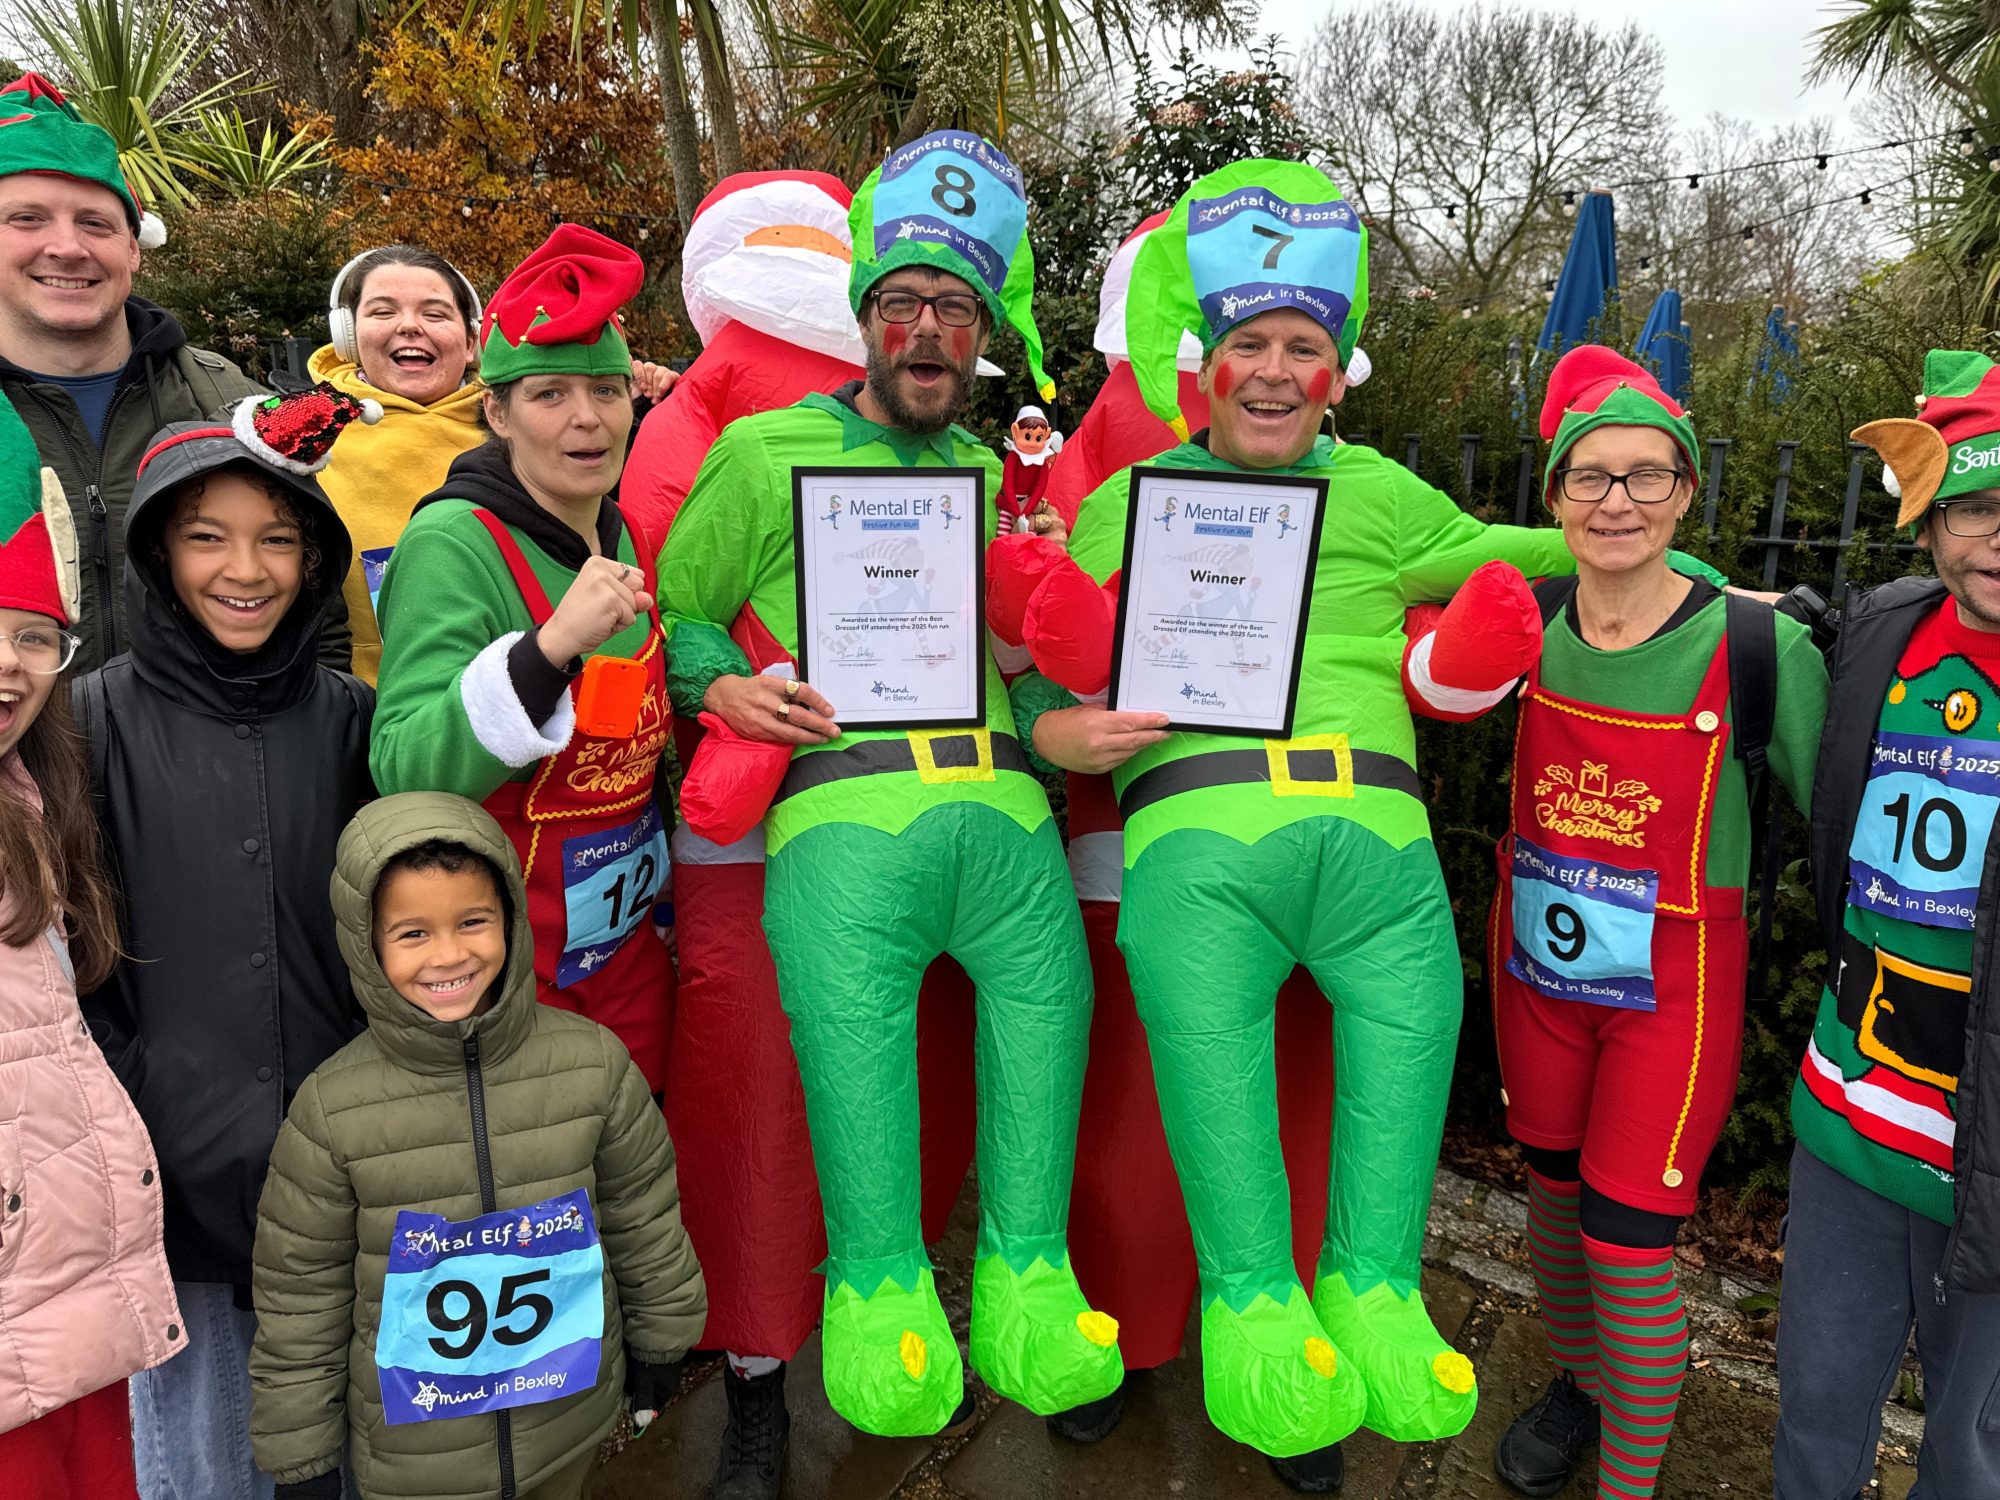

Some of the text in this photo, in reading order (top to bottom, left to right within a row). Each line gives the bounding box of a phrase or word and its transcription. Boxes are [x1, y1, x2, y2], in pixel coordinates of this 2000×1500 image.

[896, 137, 1013, 178] Mental Elf 2025
[931, 164, 977, 218] 8
[1207, 196, 1338, 222] Mental Elf 2025
[913, 223, 992, 275] mind in Bexley
[1252, 224, 1294, 269] 7
[1236, 289, 1275, 310] mind
[1296, 290, 1331, 318] Bexley
[850, 498, 933, 517] Mental Elf
[1184, 503, 1271, 524] Mental Elf
[863, 520, 918, 529] Festive Fun Run
[1196, 525, 1222, 534] Festive
[1223, 527, 1236, 535] Fun
[864, 566, 919, 578] Winner
[1190, 569, 1246, 586] Winner
[893, 695, 918, 703] Bexley
[1194, 688, 1218, 698] mind
[1201, 699, 1226, 708] Bexley
[1872, 745, 2000, 775] Mental Elf 2025
[1535, 803, 1646, 848] Christmas
[1555, 791, 1647, 831] Merry
[1883, 792, 1967, 872] 10
[582, 835, 632, 862] Mental
[1523, 850, 1636, 891] Mental Elf 2025
[603, 854, 655, 930] 12
[1878, 889, 1976, 922] mind in Bexley
[1545, 902, 1587, 962] 9
[1566, 982, 1579, 992] in
[1581, 983, 1625, 1000] Bexley
[482, 1223, 514, 1247] Elf
[535, 1213, 573, 1238] 2025
[426, 1268, 554, 1360] 95
[437, 1371, 568, 1406] mind in Bexley
